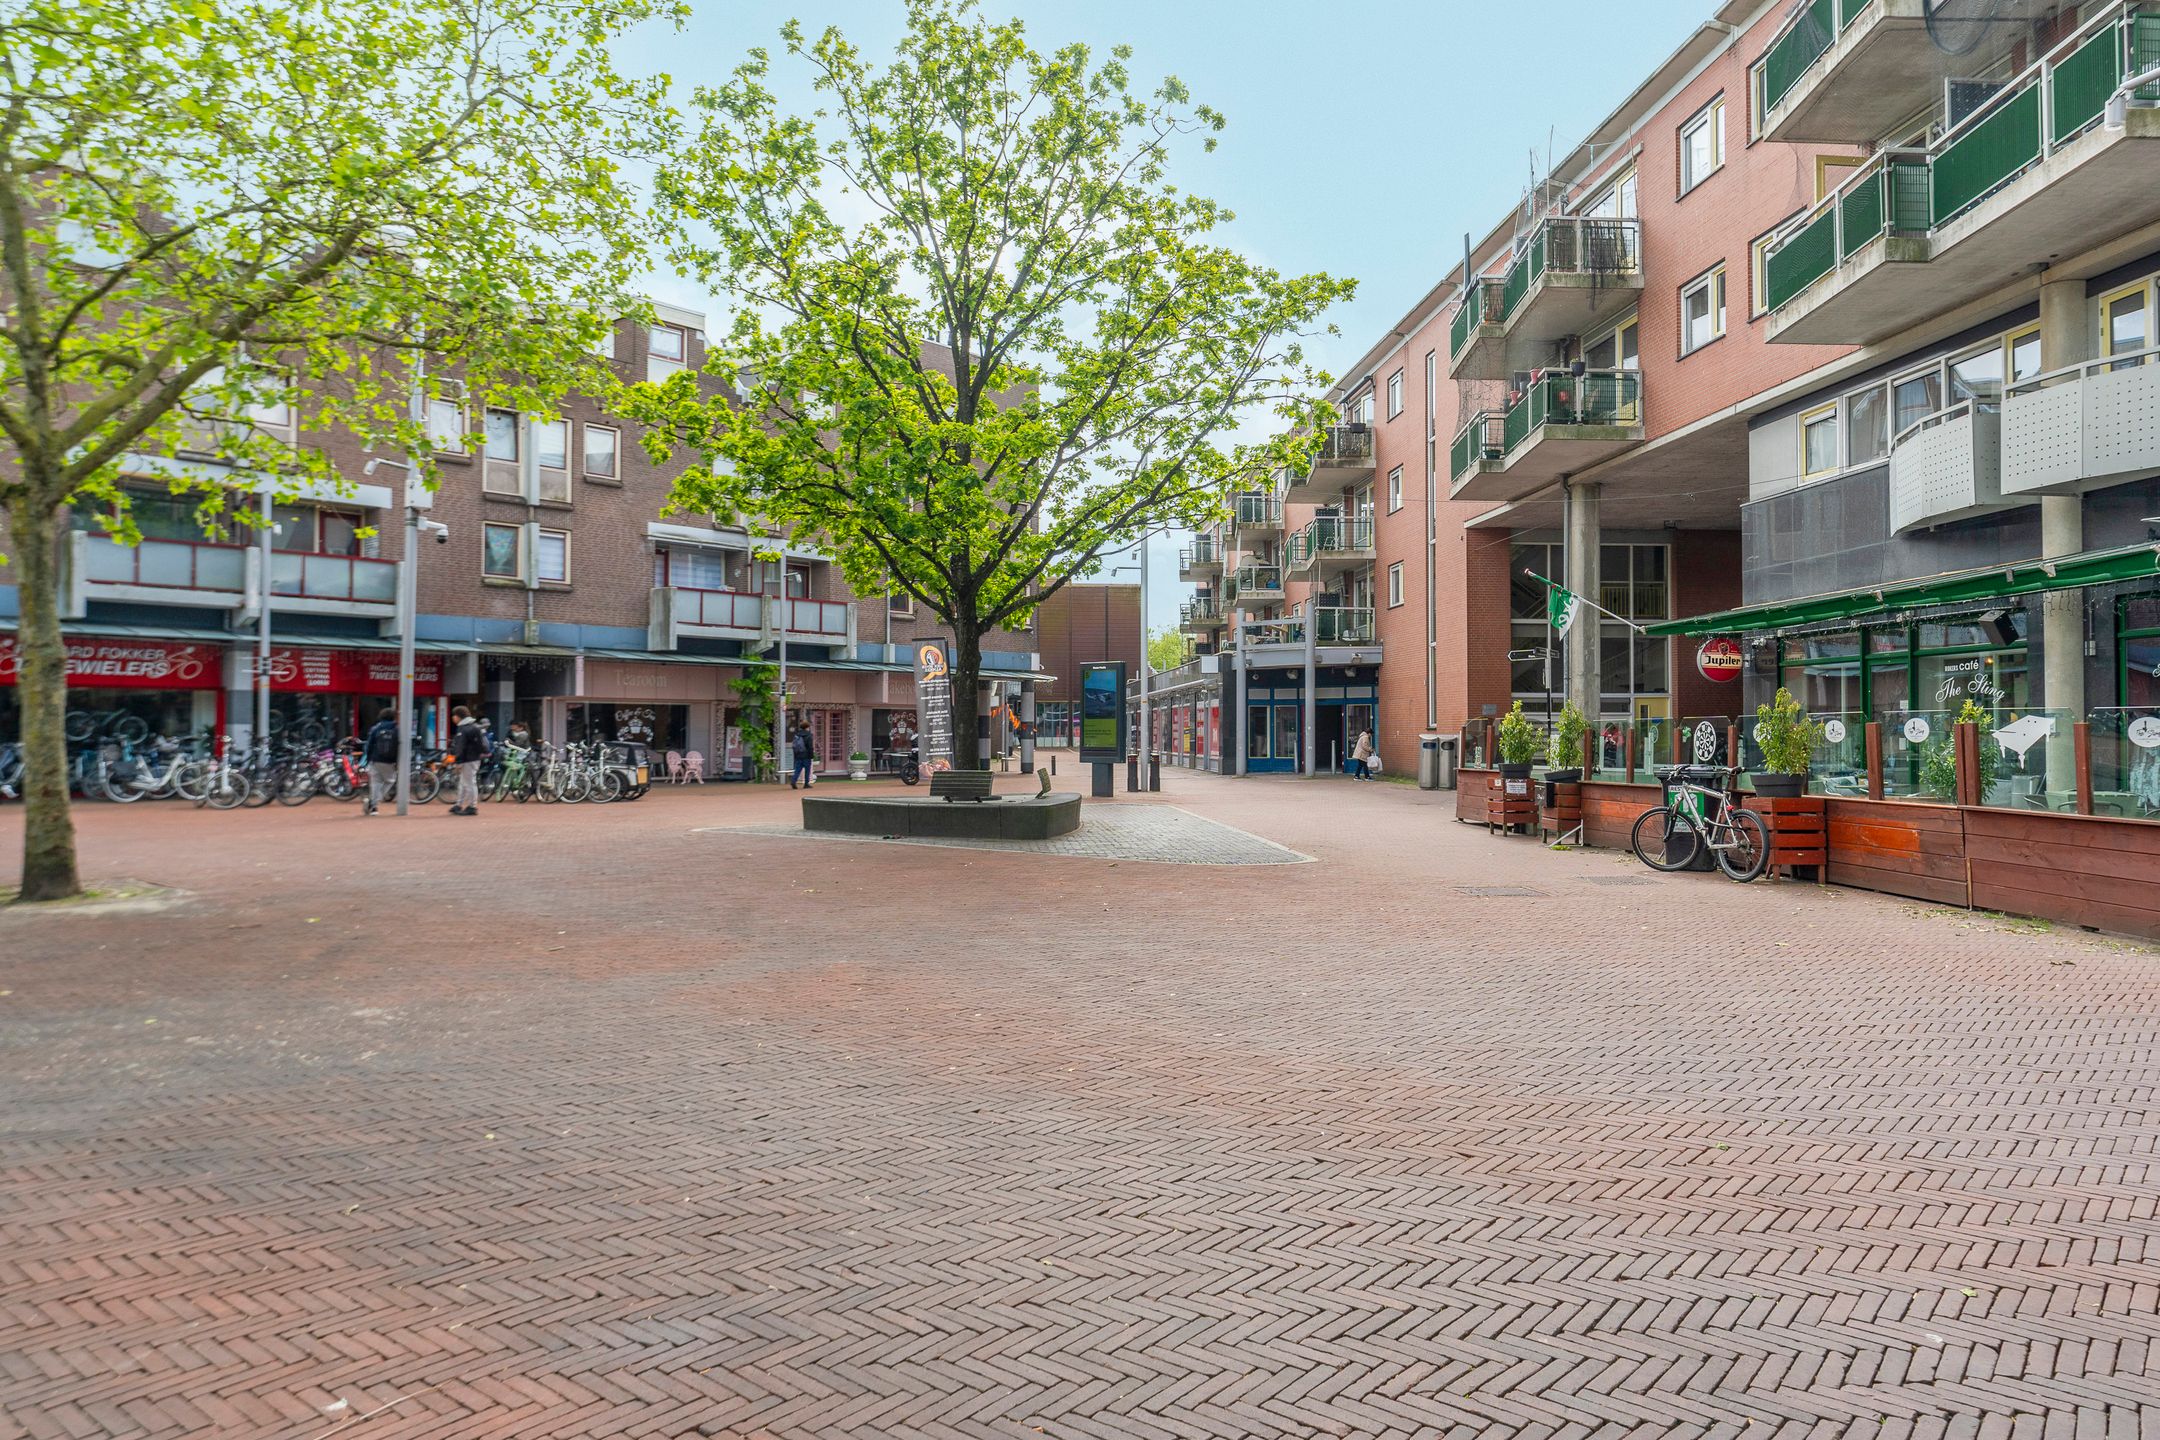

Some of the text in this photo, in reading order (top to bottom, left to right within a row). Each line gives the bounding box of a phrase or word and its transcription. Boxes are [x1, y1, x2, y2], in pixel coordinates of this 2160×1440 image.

[99, 647, 167, 660] FOKKER
[1704, 655, 1741, 667] Jupiler
[13, 657, 170, 677] TEWIELERS
[368, 672, 439, 682] TWEELERS
[613, 668, 668, 688] Tearoom
[1935, 672, 2006, 704] The Sting
